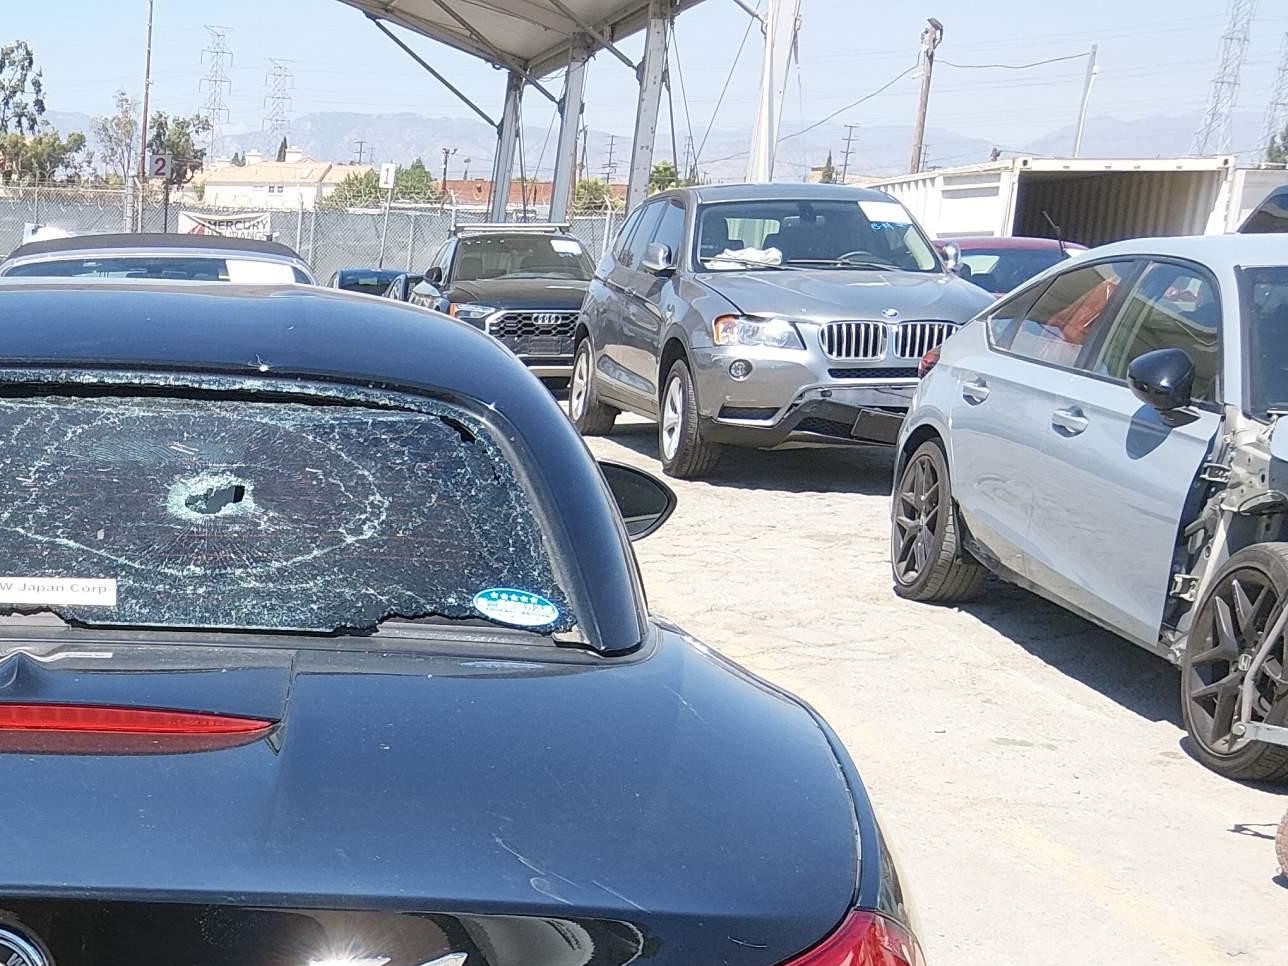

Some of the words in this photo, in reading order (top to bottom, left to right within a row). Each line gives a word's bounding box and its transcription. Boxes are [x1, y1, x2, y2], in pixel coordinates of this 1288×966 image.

[154, 157, 166, 176] 2
[383, 167, 390, 184] 1
[207, 219, 268, 232] MERCURY
[18, 582, 65, 593] Japan
